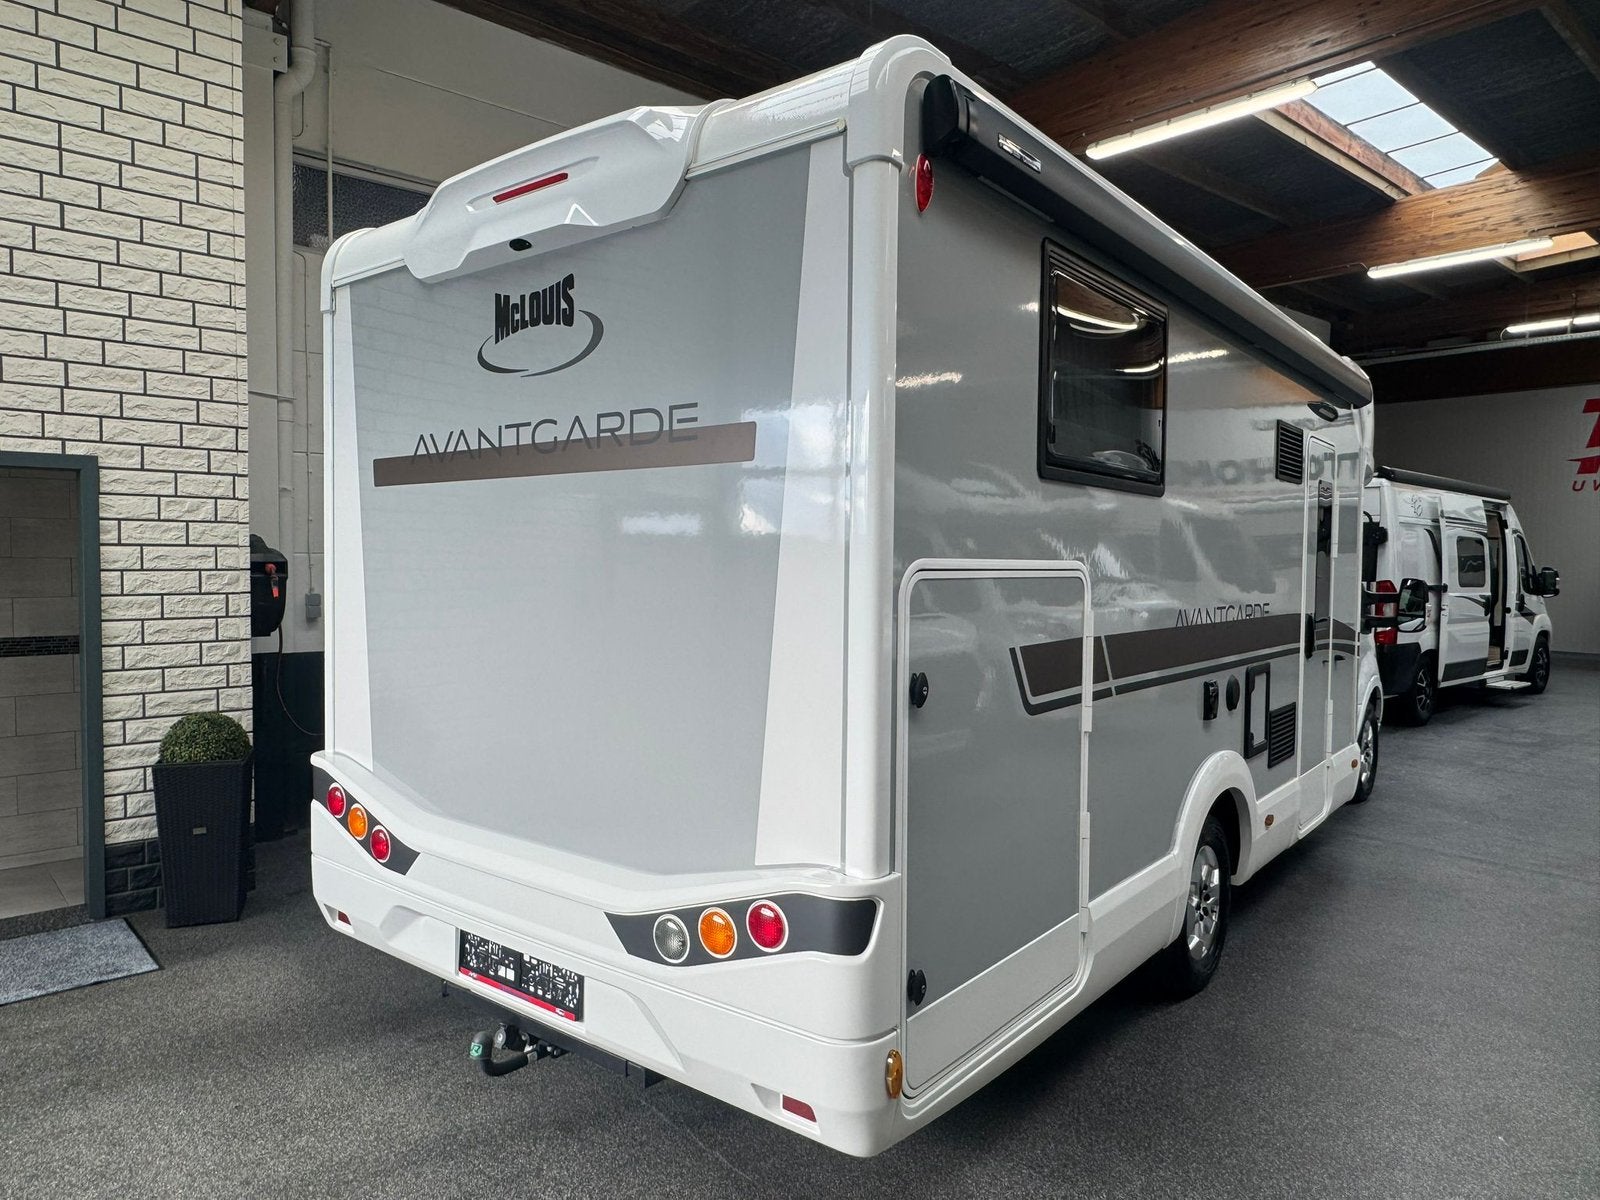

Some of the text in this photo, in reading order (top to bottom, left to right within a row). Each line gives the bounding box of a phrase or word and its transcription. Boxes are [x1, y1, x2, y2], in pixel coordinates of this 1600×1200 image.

[494, 273, 575, 344] McLOUIS
[411, 402, 698, 463] AVANTGARDE
[1175, 602, 1270, 628] AVANTGARDE
